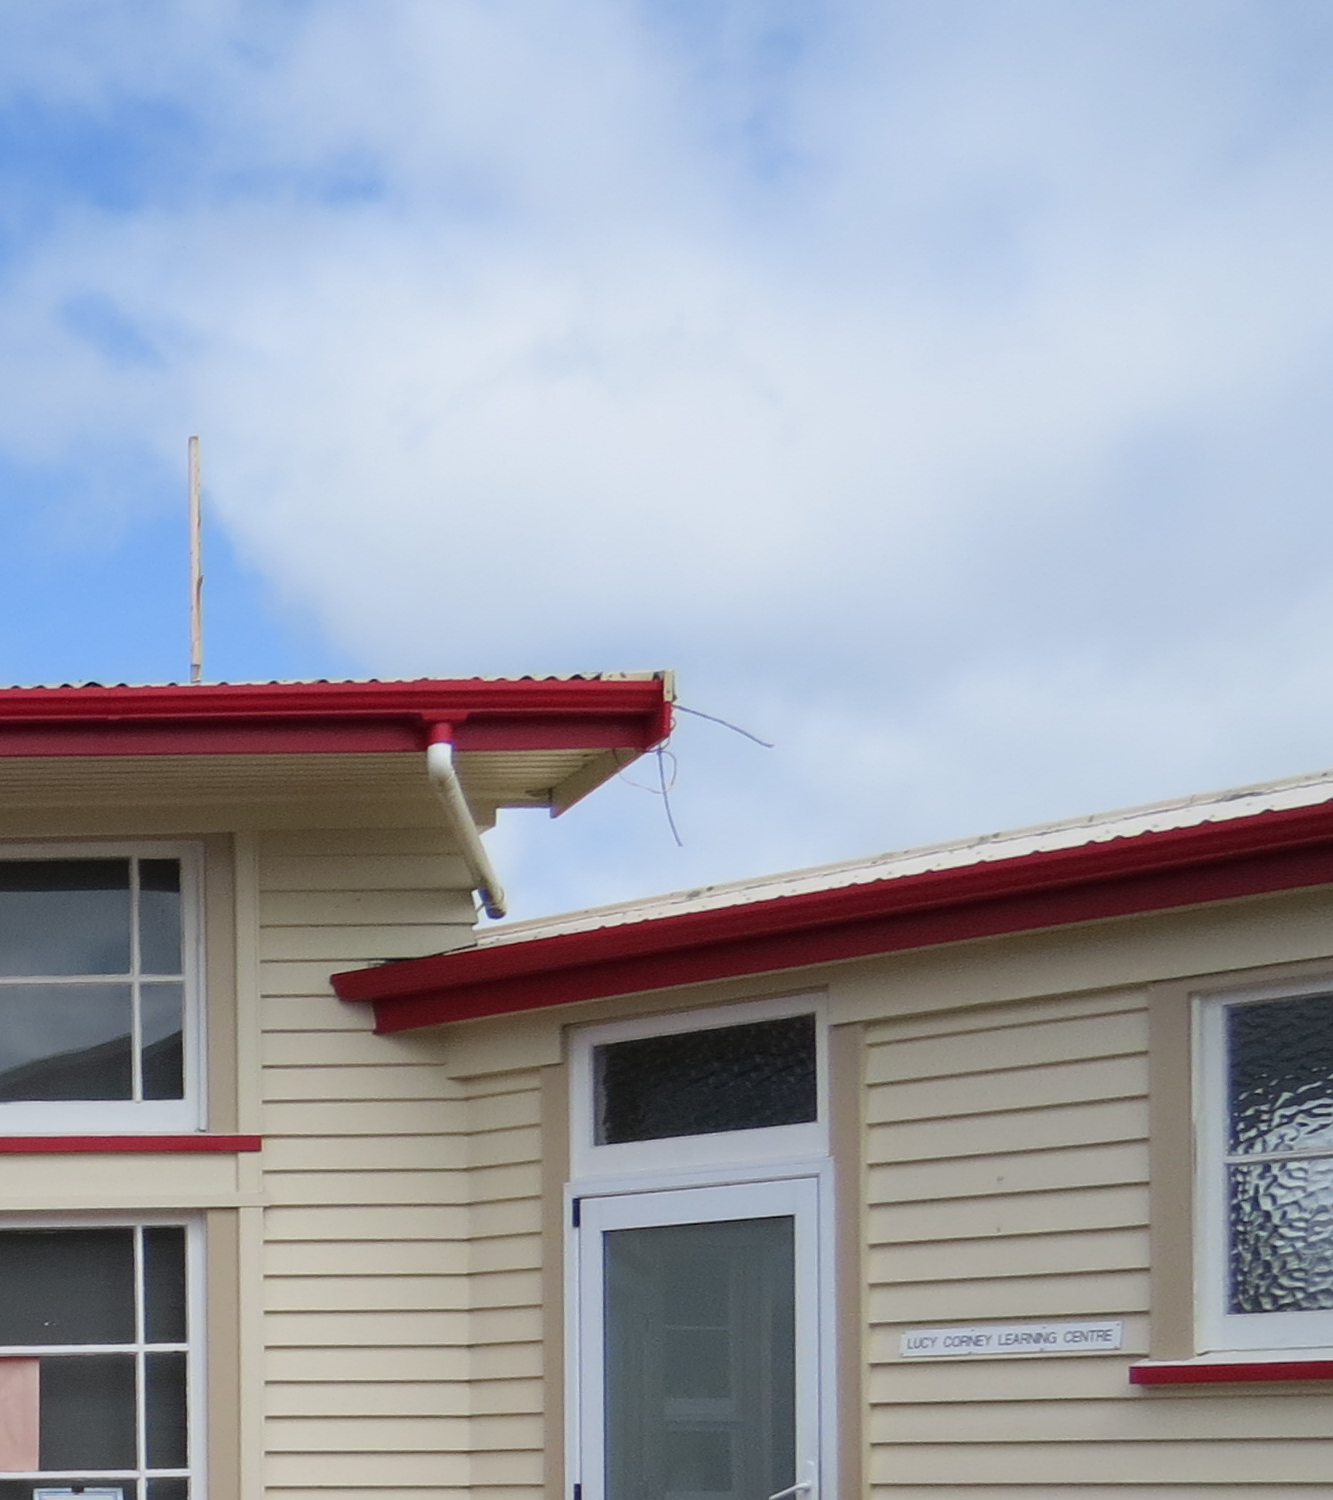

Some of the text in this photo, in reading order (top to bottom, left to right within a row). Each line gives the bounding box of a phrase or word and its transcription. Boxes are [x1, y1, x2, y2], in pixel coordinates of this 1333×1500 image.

[907, 1329, 1114, 1349] LUCY CORNEY LEARNING CENTRE
